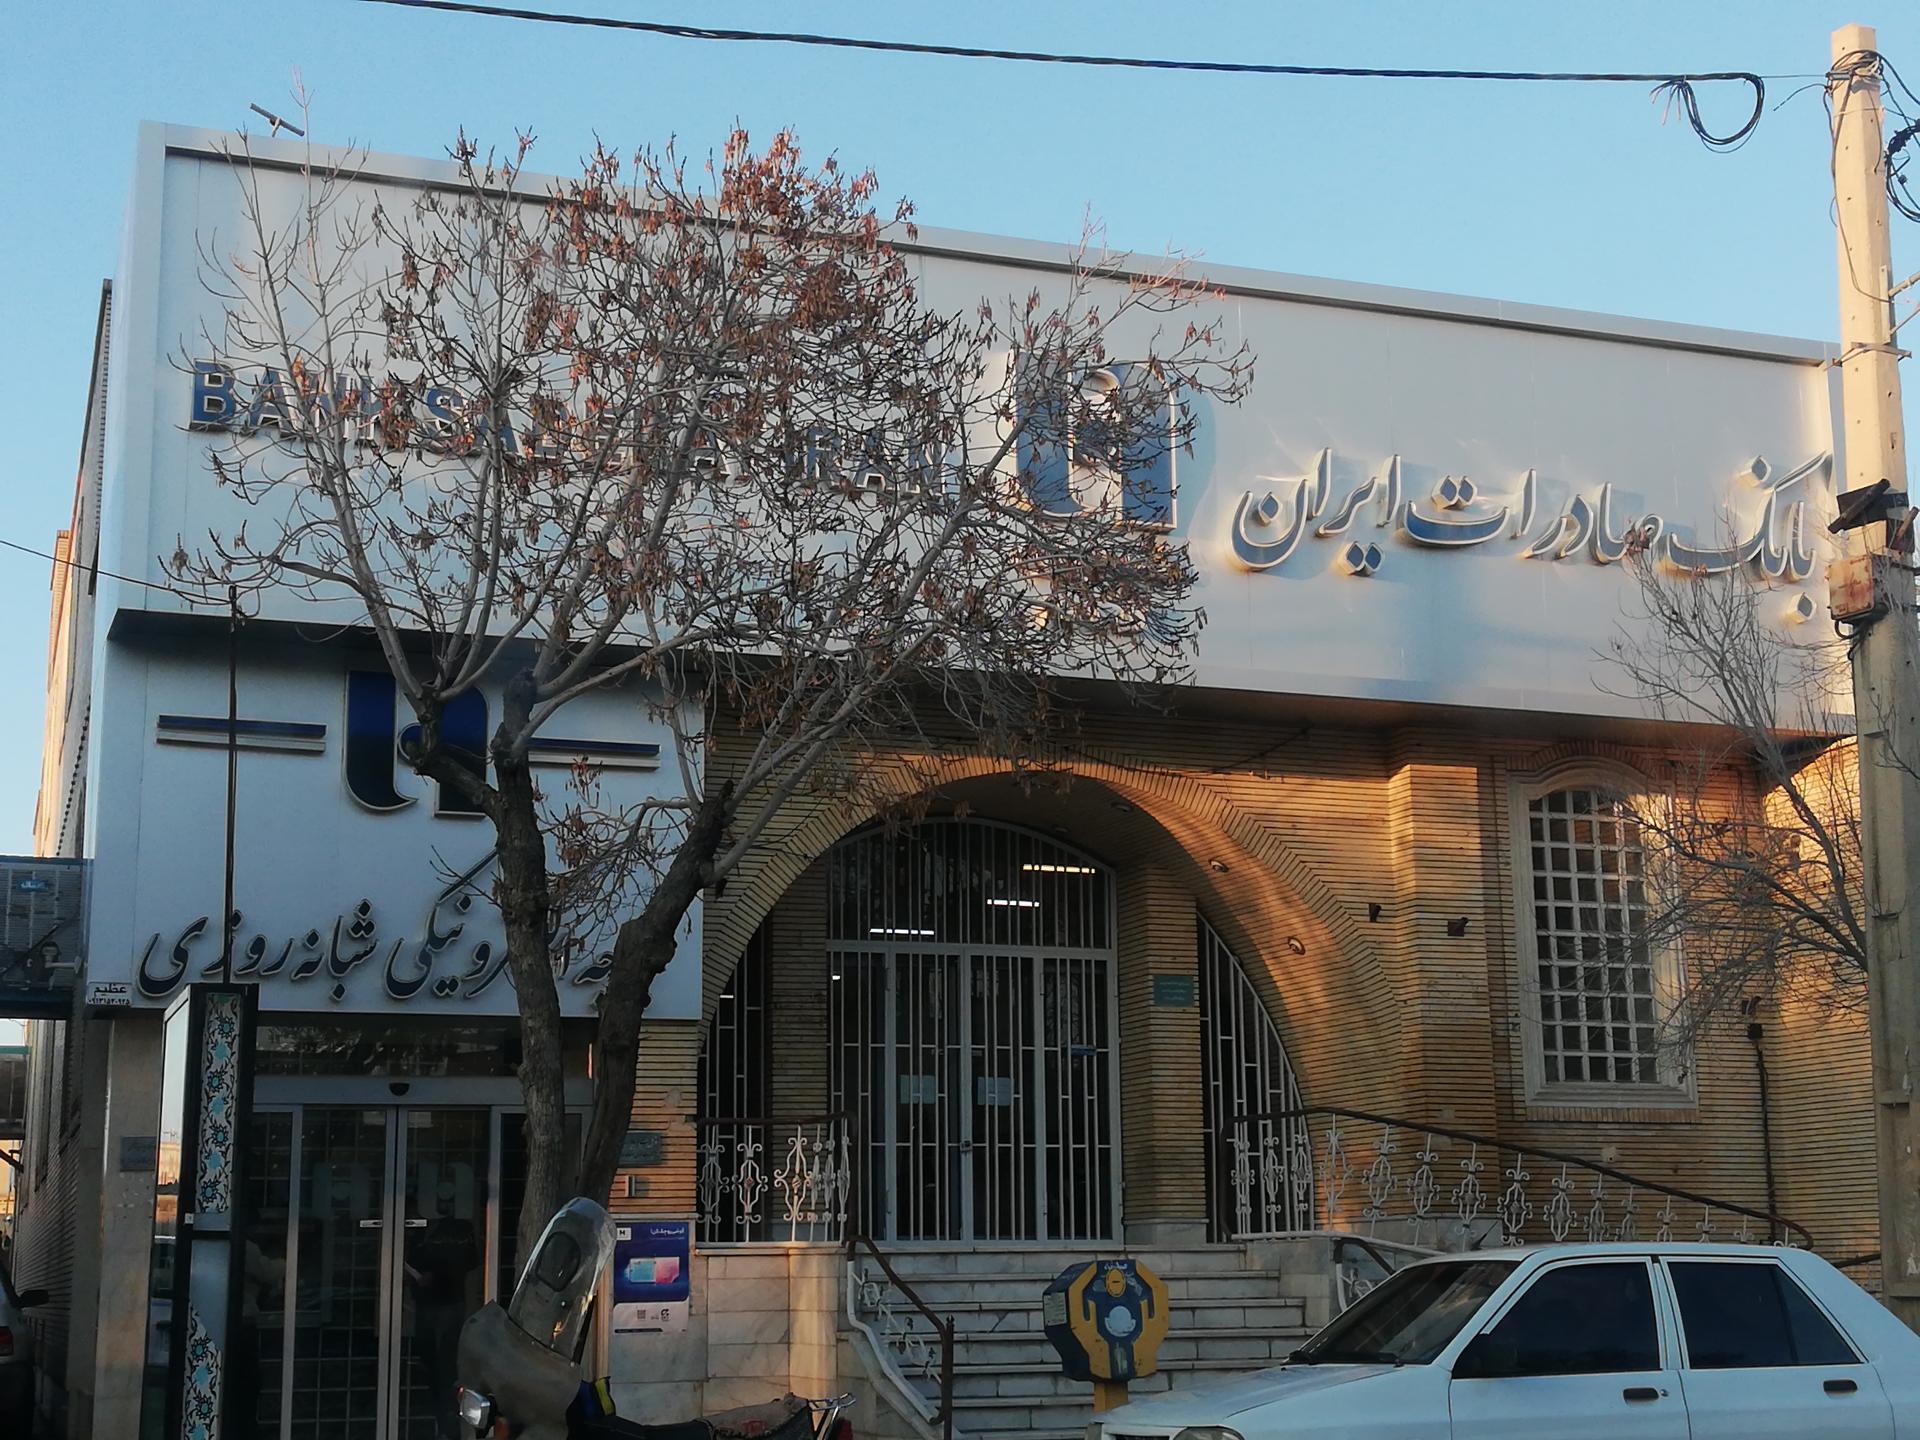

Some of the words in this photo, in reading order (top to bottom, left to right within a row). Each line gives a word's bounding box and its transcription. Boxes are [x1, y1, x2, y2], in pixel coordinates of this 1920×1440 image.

[1230, 447, 1403, 577] ایران
[1402, 466, 1665, 564] صادرات
[1663, 451, 1834, 624] بانک
